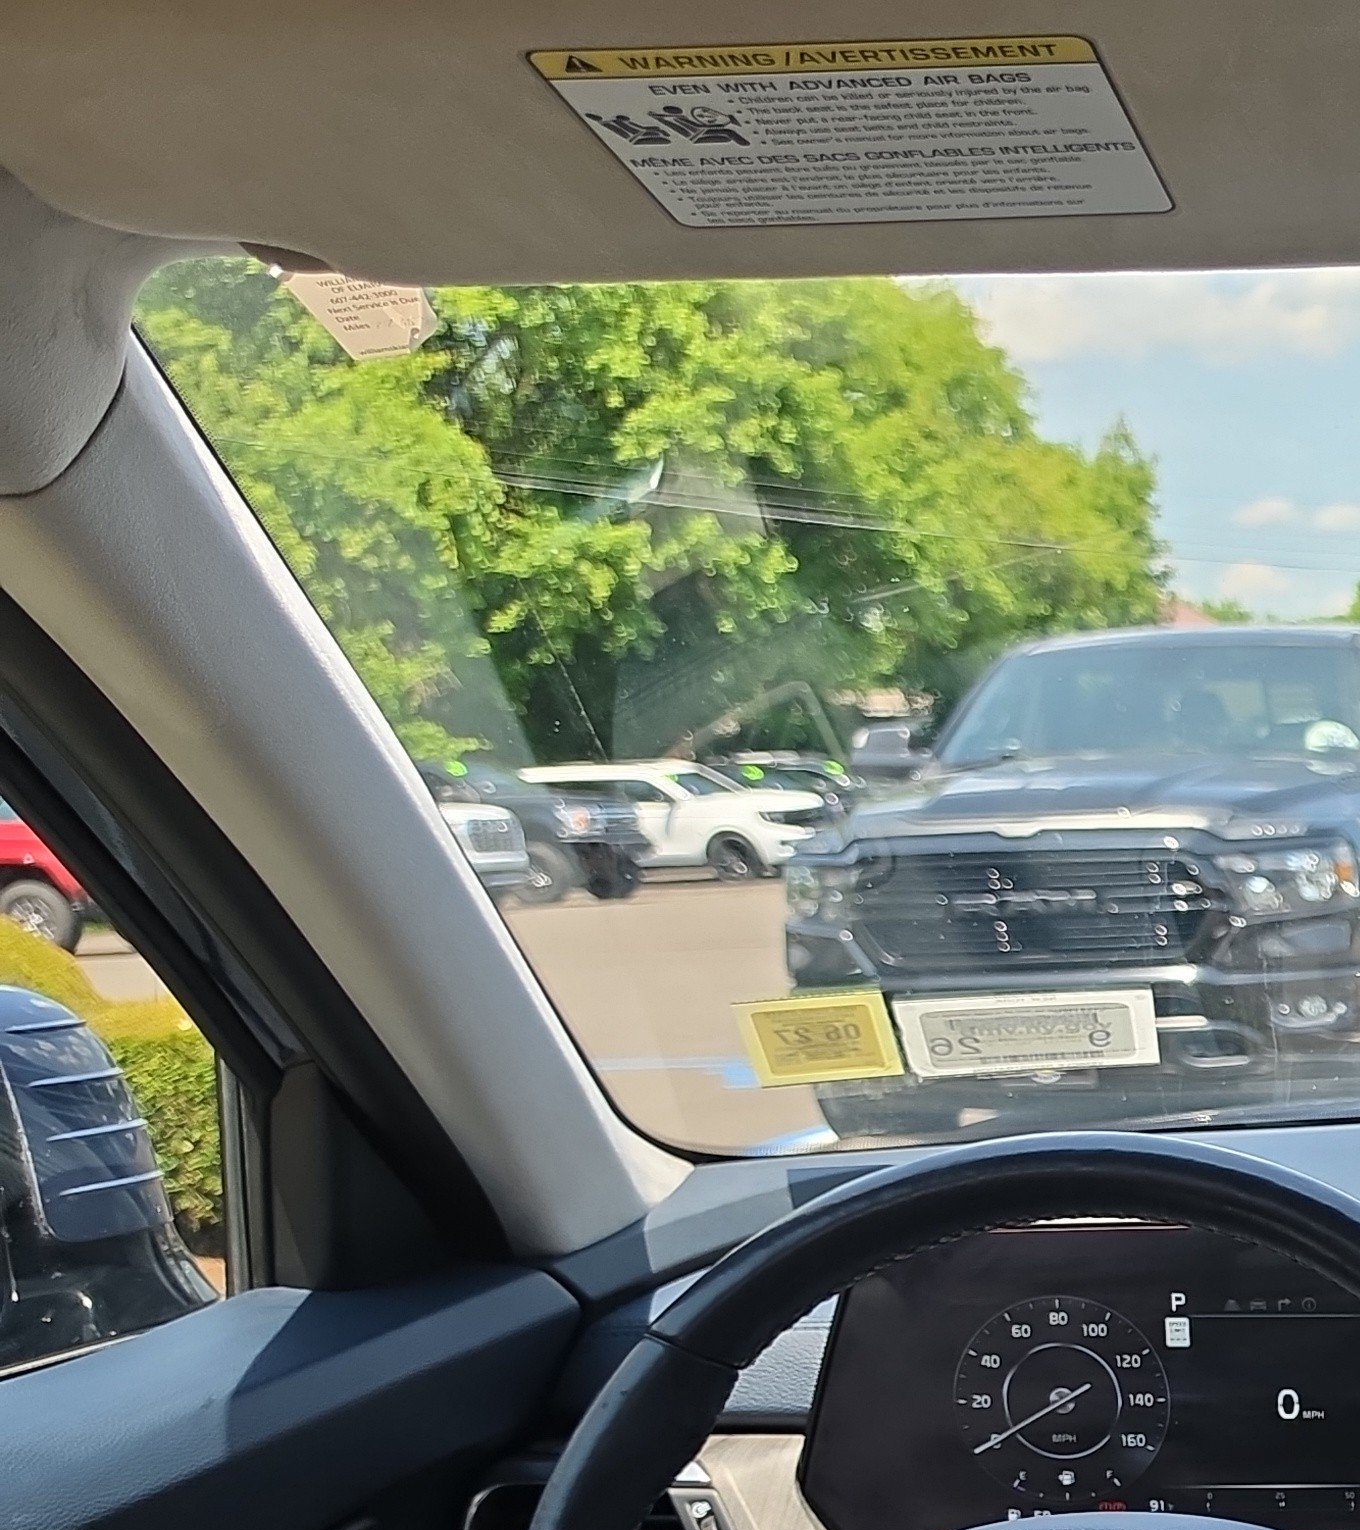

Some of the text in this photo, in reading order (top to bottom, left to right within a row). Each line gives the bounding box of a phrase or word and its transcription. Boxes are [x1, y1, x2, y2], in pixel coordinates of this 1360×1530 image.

[618, 52, 776, 71] WARNING
[801, 44, 1057, 64] AVERTISSEMENT
[648, 73, 1033, 96] EVEN WITH ADVANCED AIR BAGS
[700, 157, 753, 167] AVEC
[757, 154, 799, 165] DES
[803, 152, 860, 163] SACS
[999, 141, 1136, 156] INTELLIGENTS
[327, 296, 419, 315] Next Service Due
[335, 314, 361, 324] Date
[343, 322, 371, 333] Miles
[1170, 1293, 1186, 1312] P
[1049, 1312, 1068, 1326] 80
[1011, 1324, 1031, 1338] 60
[1081, 1324, 1108, 1338] 100
[981, 1355, 1000, 1369] 40
[1116, 1355, 1141, 1368] 120
[972, 1395, 991, 1409] 20
[1129, 1394, 1154, 1408] 140
[1277, 1388, 1325, 1420] 0 MPH
[1052, 1433, 1077, 1443] MPH
[1121, 1434, 1147, 1447] 160
